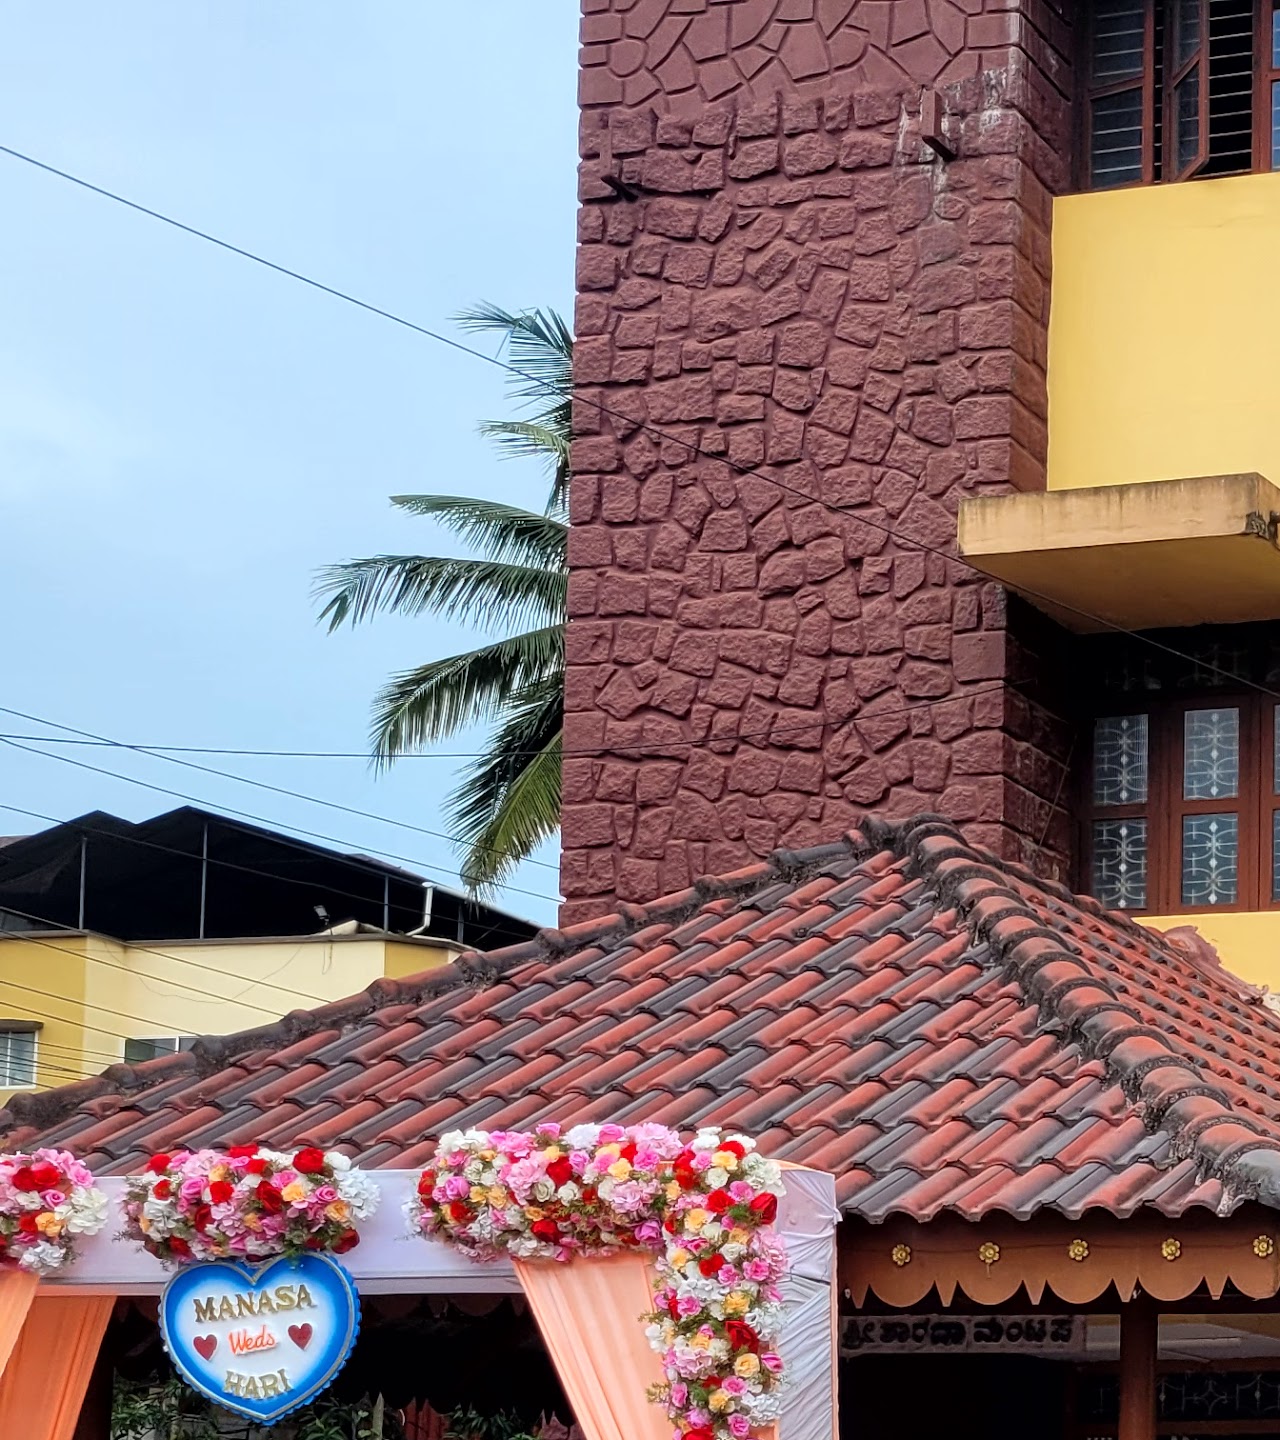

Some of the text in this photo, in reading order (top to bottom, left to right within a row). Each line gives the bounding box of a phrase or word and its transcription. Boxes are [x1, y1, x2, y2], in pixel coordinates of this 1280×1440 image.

[193, 1284, 317, 1323] MANASA
[228, 1324, 278, 1354] Weds
[223, 1368, 293, 1399] HARI
